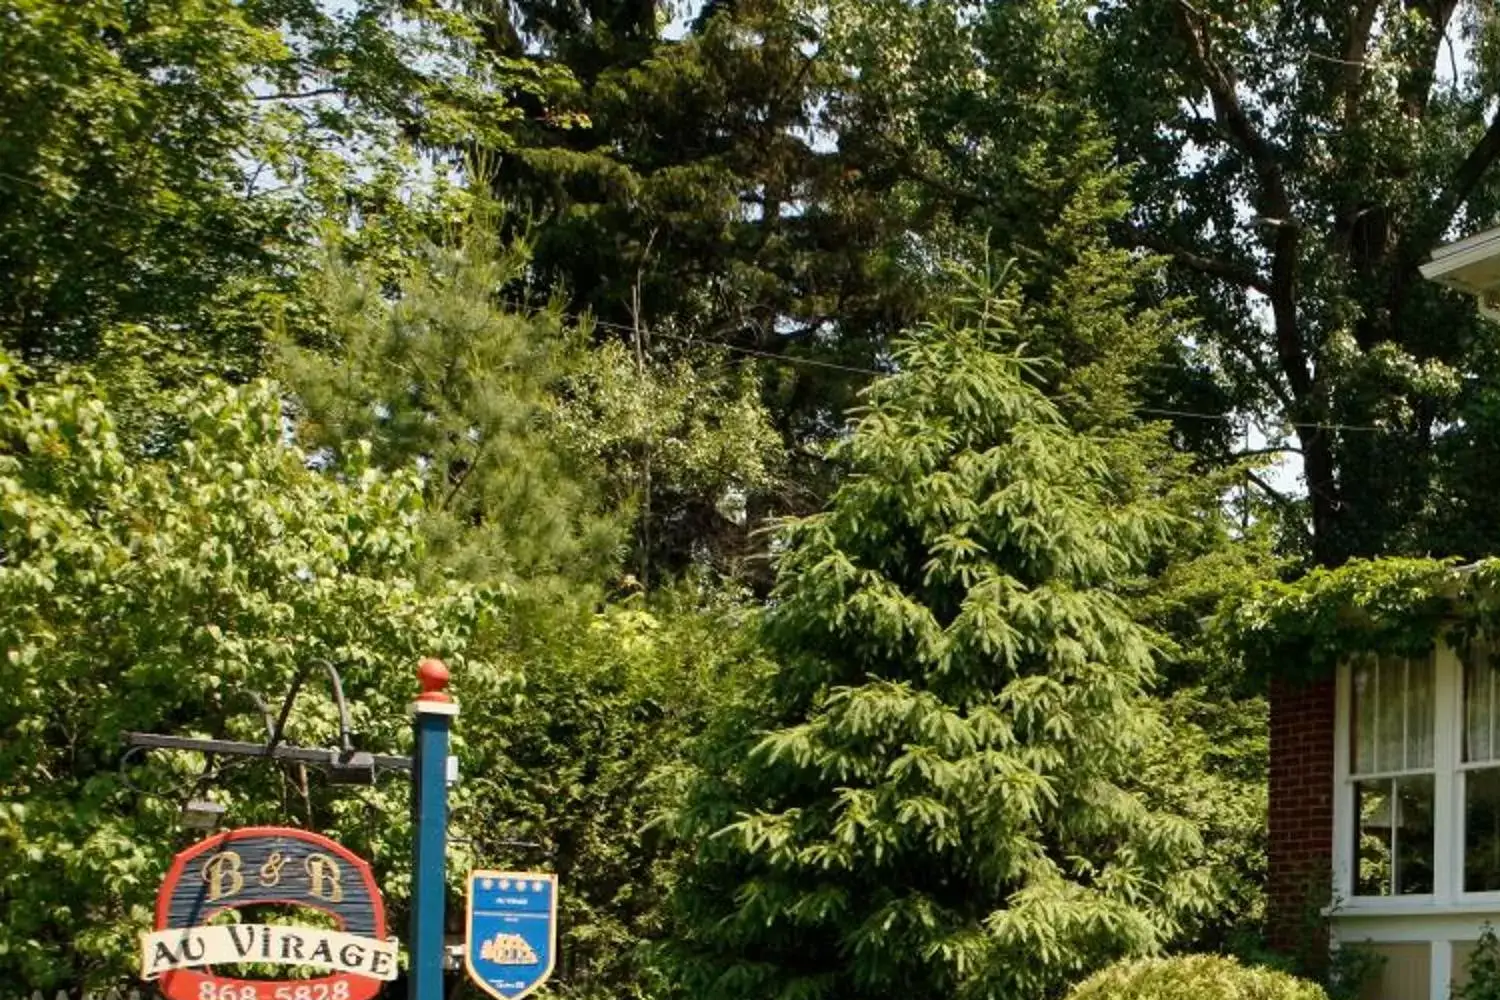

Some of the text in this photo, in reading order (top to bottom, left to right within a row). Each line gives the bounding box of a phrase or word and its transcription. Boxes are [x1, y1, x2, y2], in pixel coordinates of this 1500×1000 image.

[202, 851, 342, 902] B & B
[152, 937, 205, 969] AU
